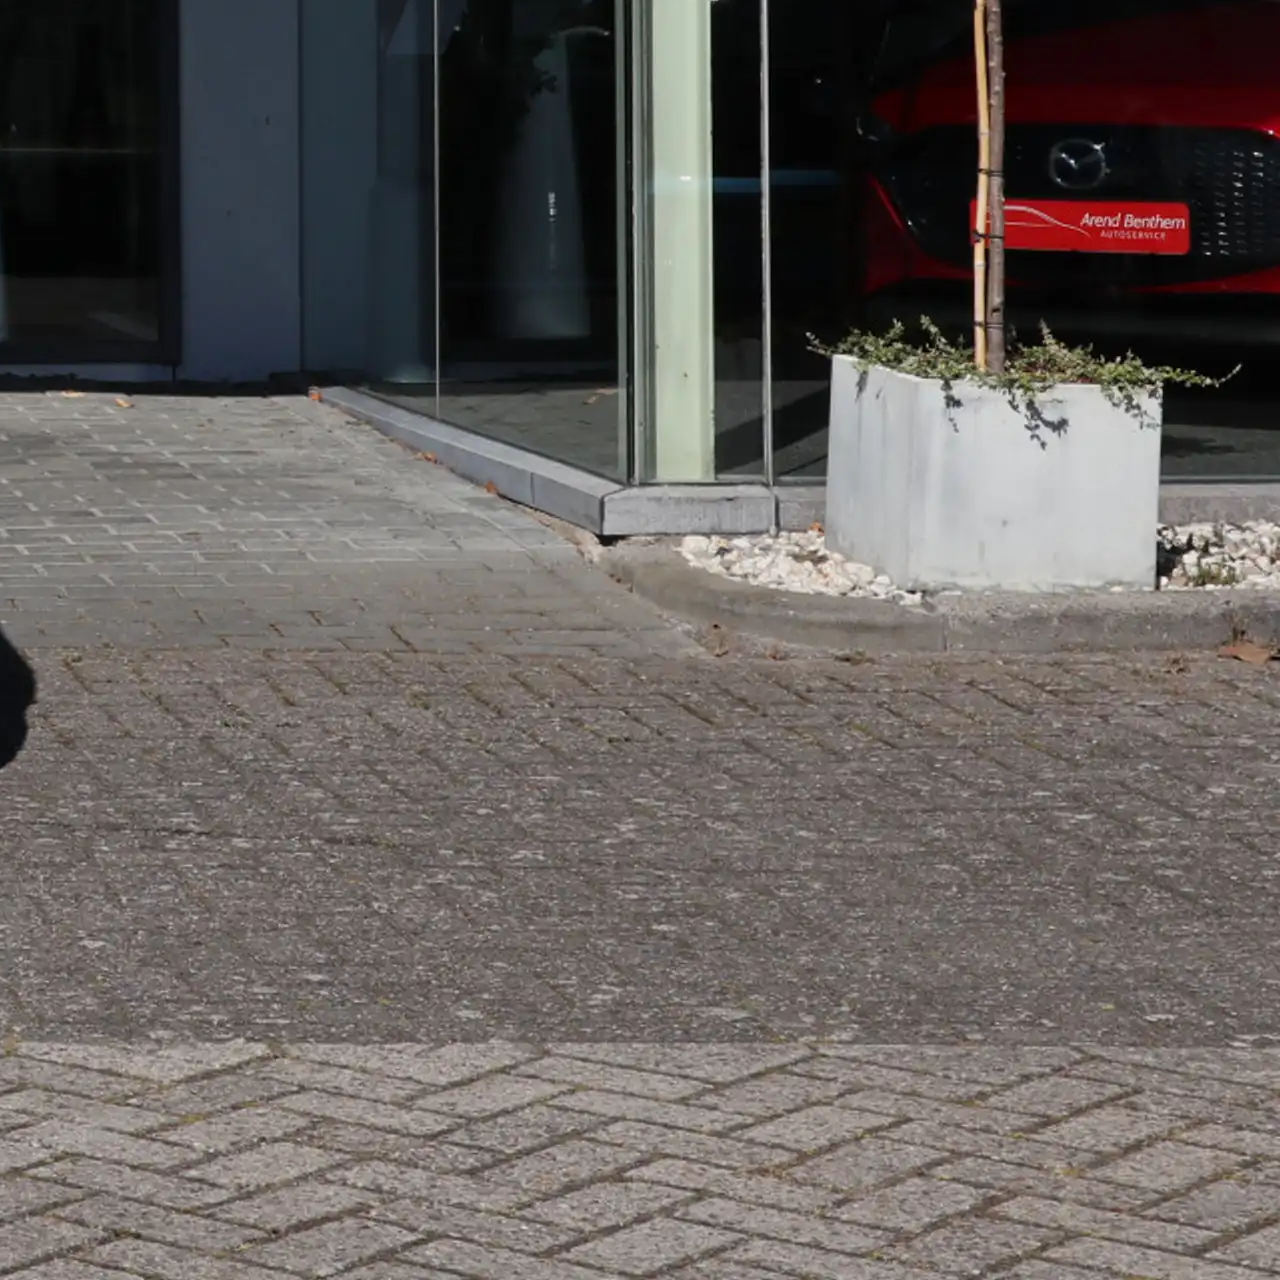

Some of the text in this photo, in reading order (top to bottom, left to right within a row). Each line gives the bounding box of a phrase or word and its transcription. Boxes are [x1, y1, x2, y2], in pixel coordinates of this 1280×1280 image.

[1080, 212, 1186, 229] Arend Benthem
[1099, 229, 1167, 240] AUTOSERVICE
